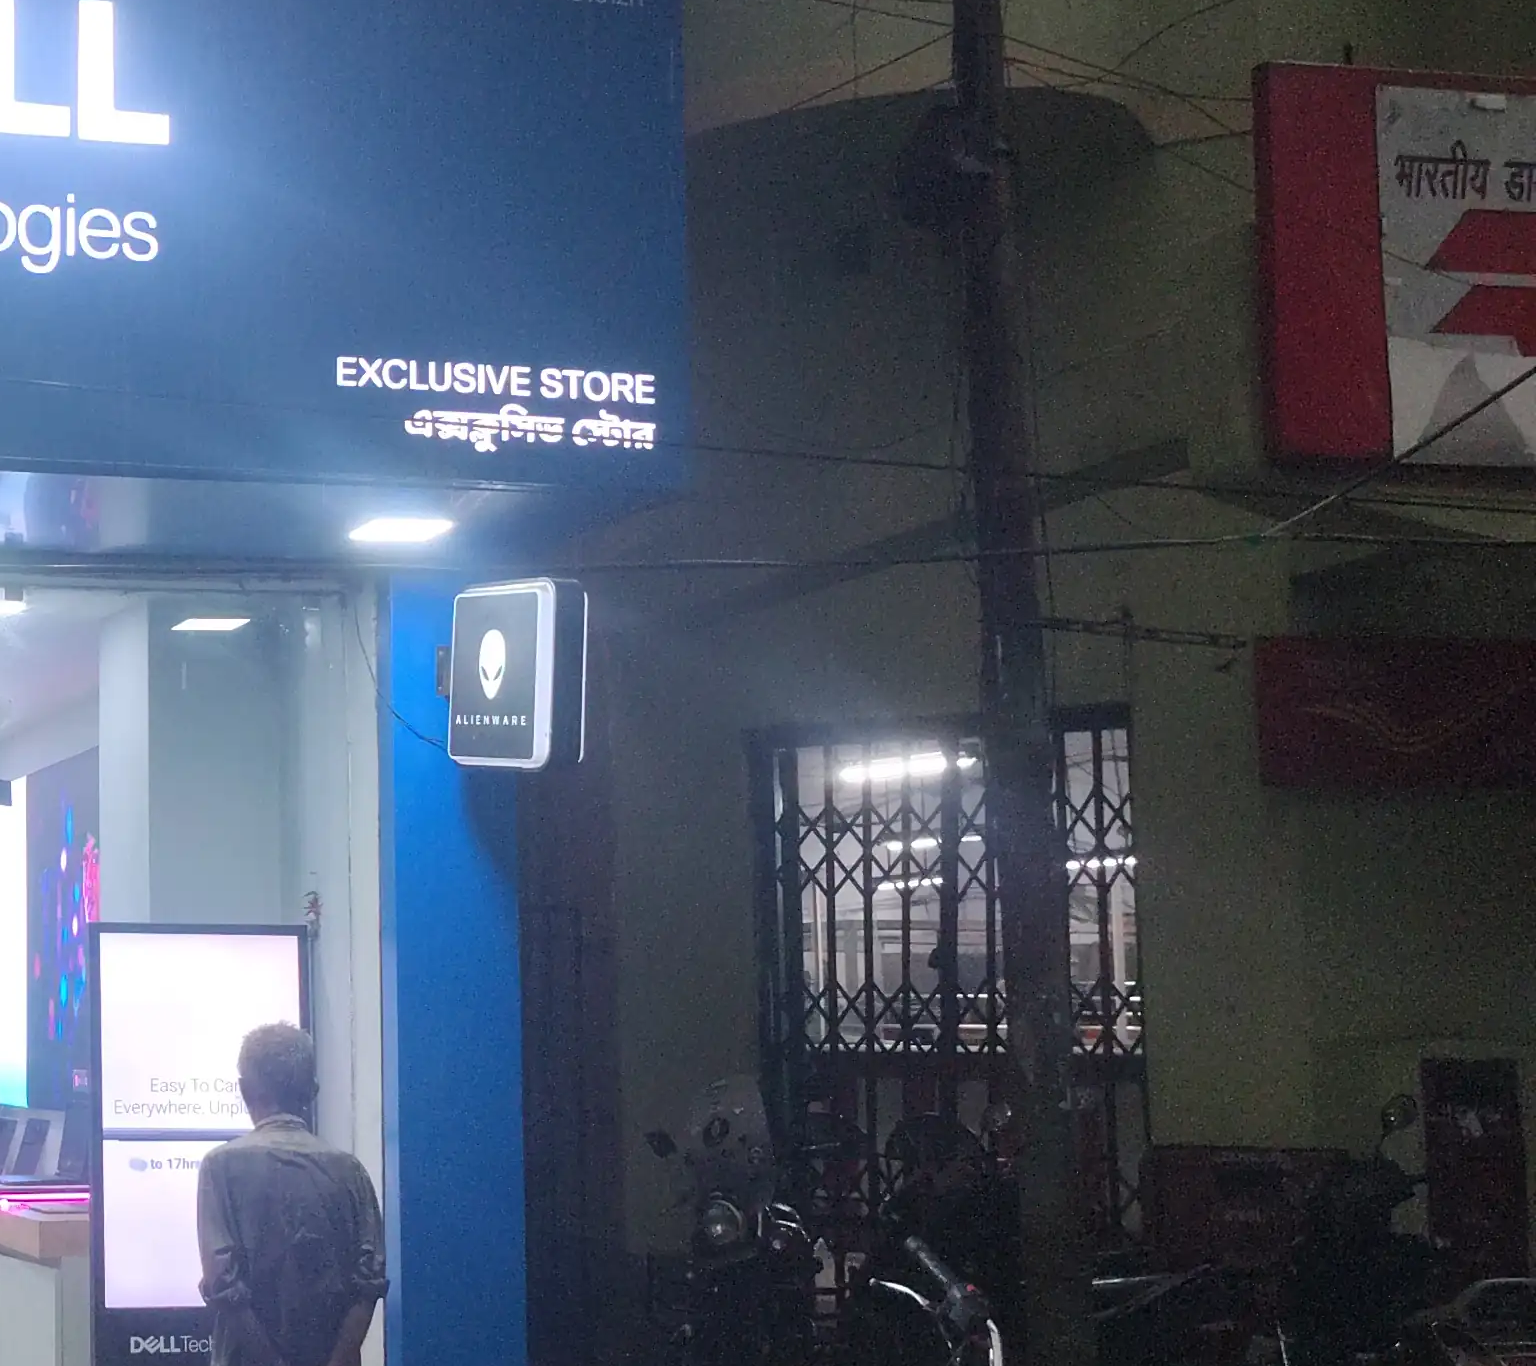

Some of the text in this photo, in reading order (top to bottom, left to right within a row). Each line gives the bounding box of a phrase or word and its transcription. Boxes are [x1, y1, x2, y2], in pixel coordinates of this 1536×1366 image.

[1394, 139, 1536, 202] भारतीय डा
[335, 356, 656, 405] EXCLUSIVE STORE
[455, 714, 528, 726] ALIENWARE
[150, 1078, 186, 1095] Easy
[191, 1078, 210, 1092] To
[150, 1159, 163, 1170] to
[167, 1158, 201, 1170] 17hr
[130, 1336, 181, 1354] DELL
